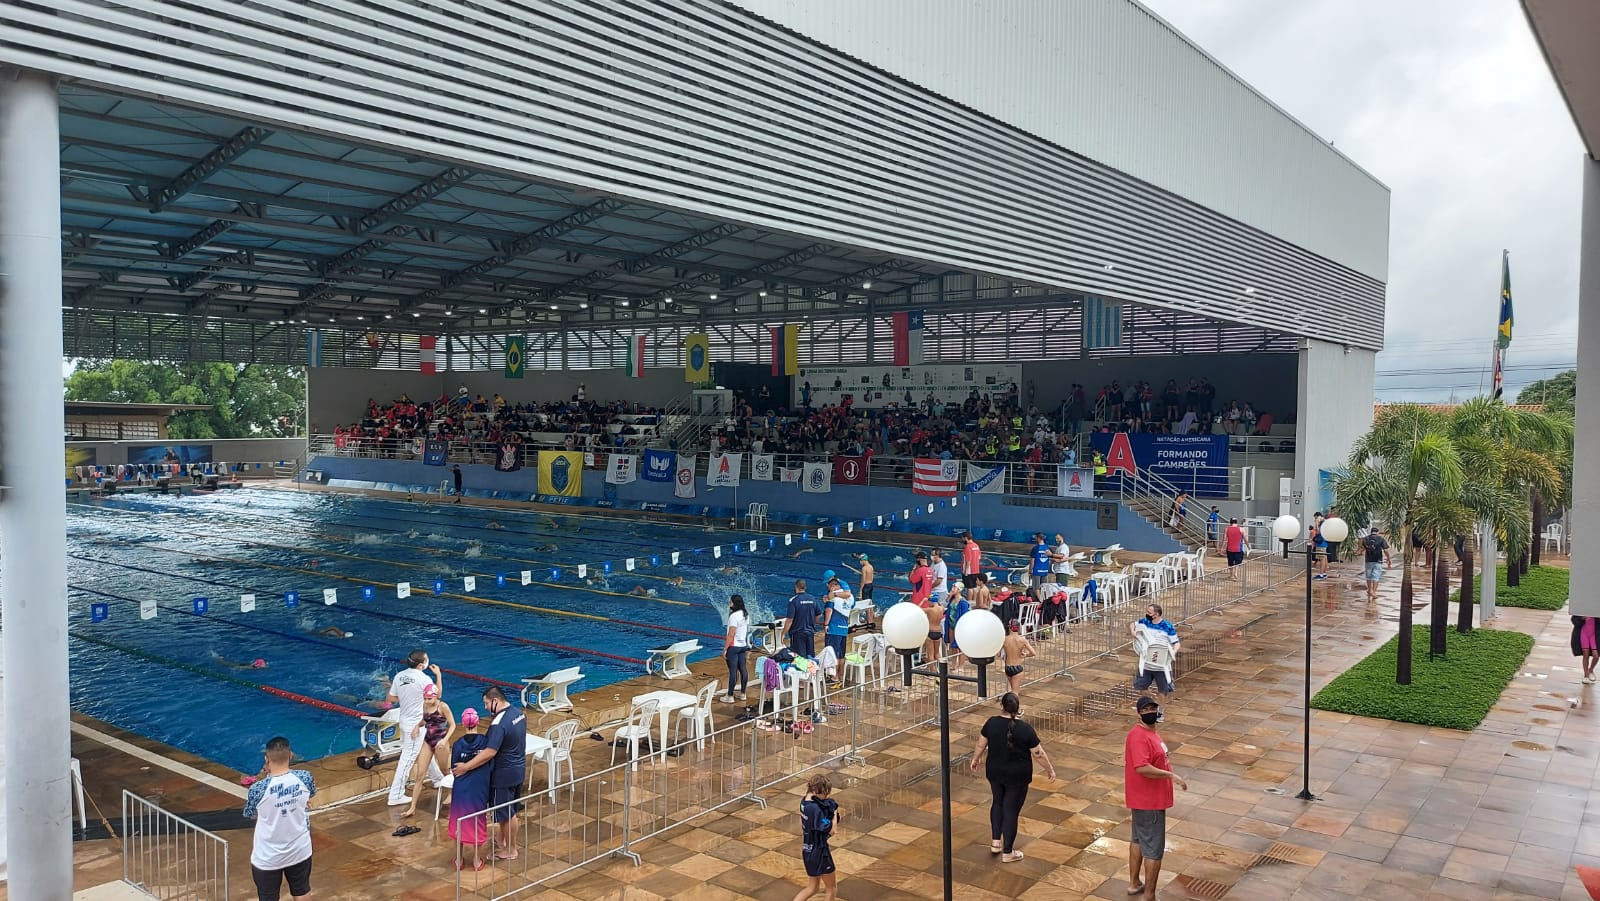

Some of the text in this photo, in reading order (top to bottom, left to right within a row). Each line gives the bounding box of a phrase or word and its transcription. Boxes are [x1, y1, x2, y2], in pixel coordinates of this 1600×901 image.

[1106, 432, 1139, 477] A
[1157, 450, 1208, 459] FORMANDO
[846, 462, 855, 478] J
[1157, 459, 1207, 469] CAMPEÕES
